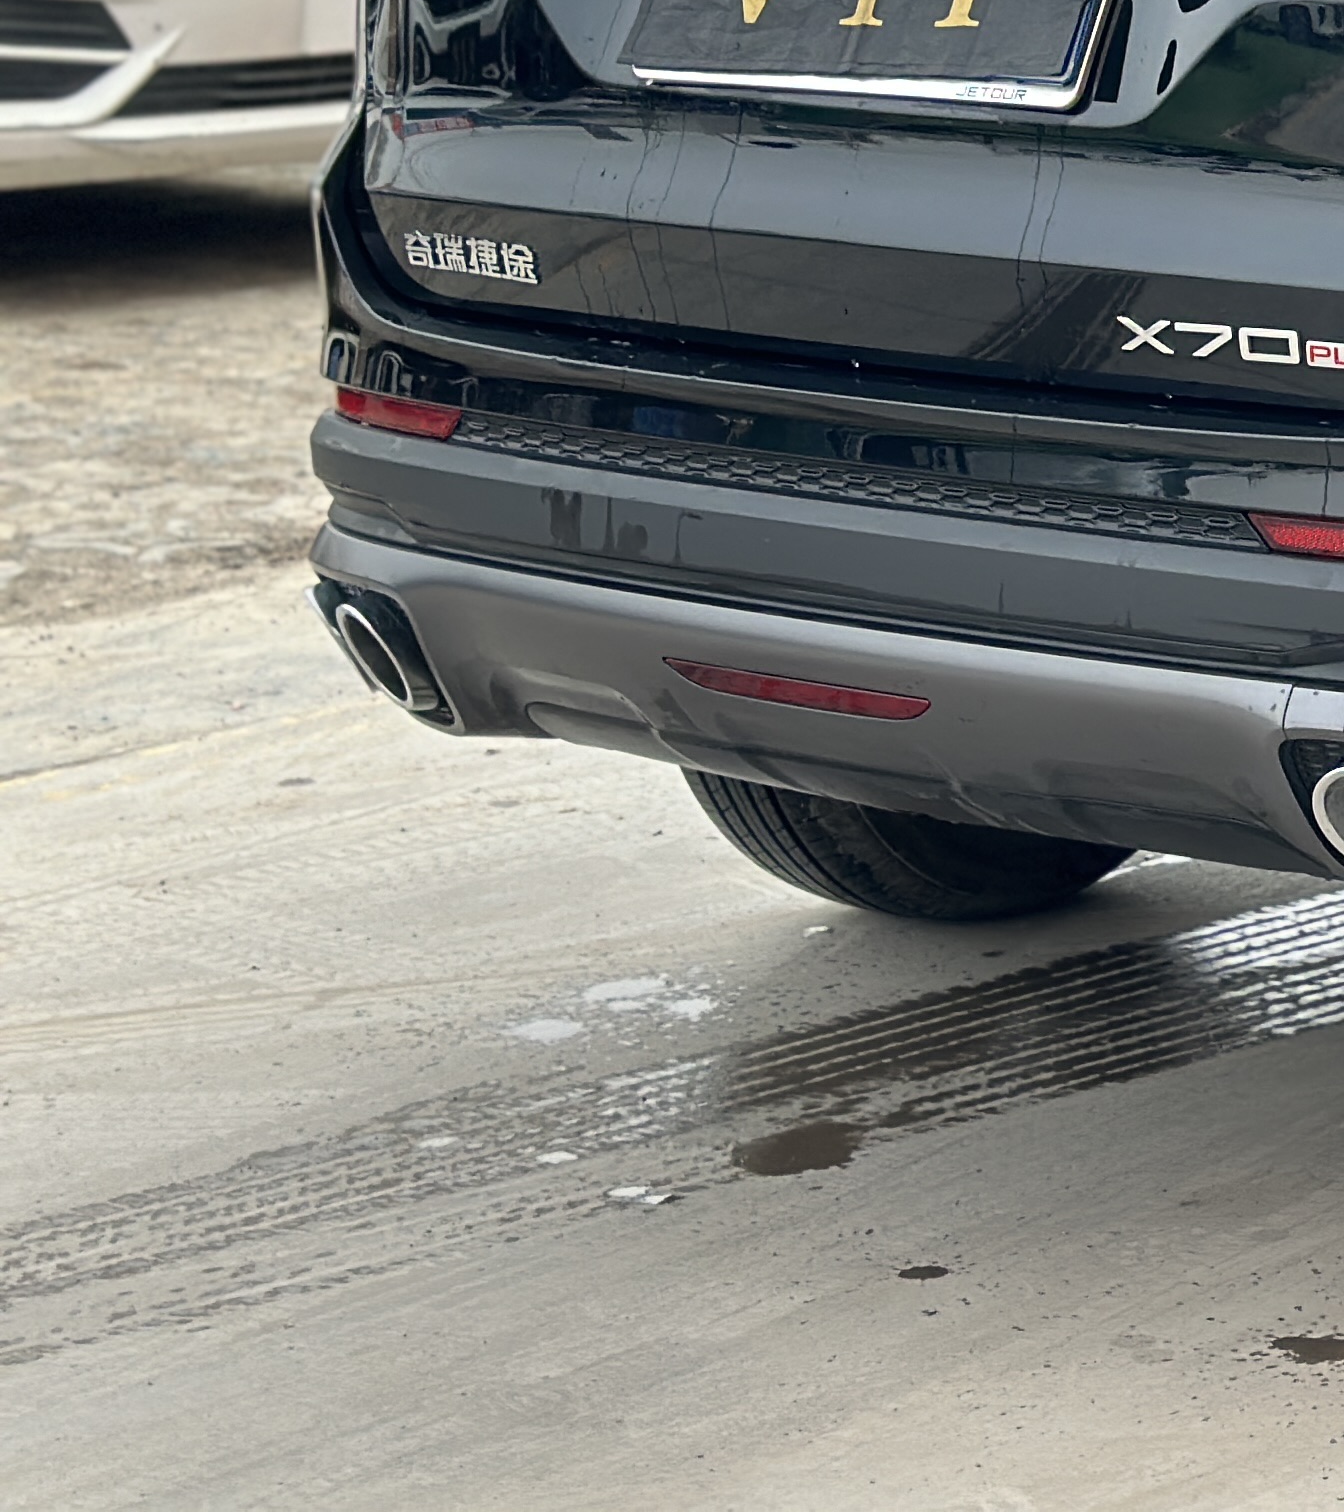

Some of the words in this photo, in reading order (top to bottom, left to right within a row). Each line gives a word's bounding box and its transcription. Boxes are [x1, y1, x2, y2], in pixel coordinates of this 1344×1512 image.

[955, 85, 1028, 102] JETOUR
[403, 229, 539, 285] 奇瑞捷途
[1116, 314, 1300, 365] X70
